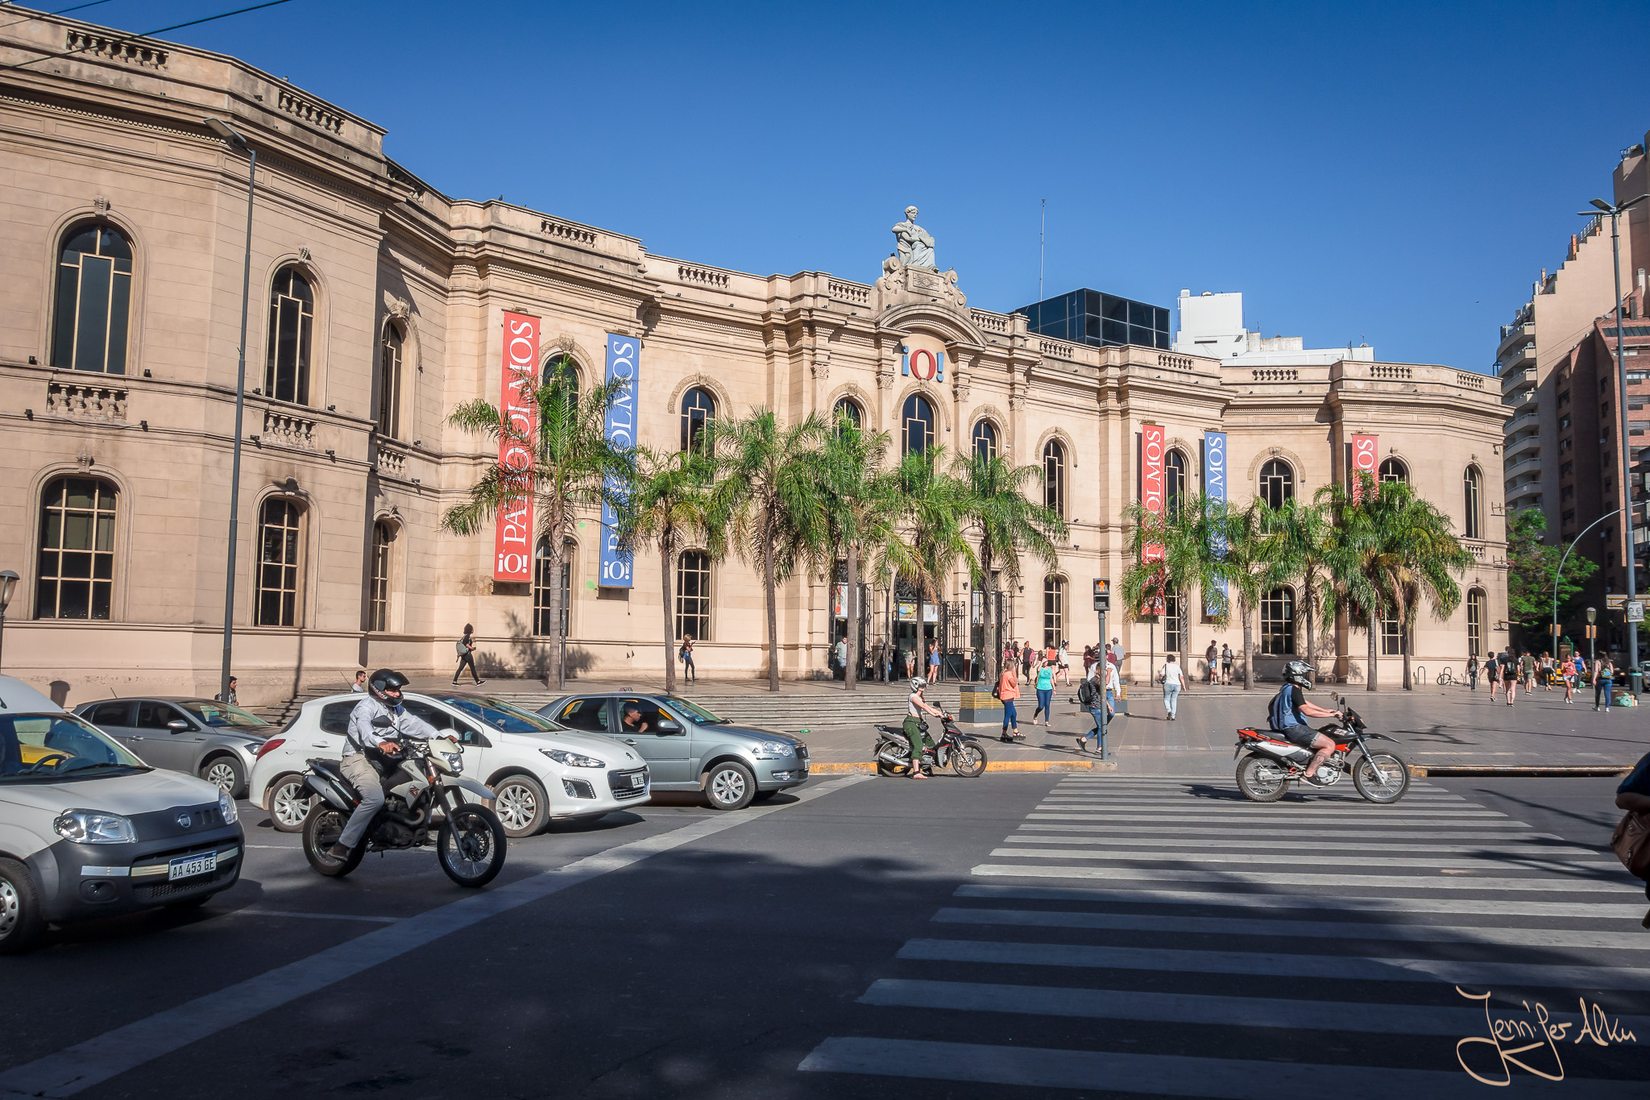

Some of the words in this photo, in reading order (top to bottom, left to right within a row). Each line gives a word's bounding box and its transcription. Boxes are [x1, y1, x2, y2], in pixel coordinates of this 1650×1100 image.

[1146, 430, 1161, 515] OLMOS
[1208, 436, 1224, 506] LMOS
[172, 865, 183, 878] AA
[186, 861, 202, 875] 453
